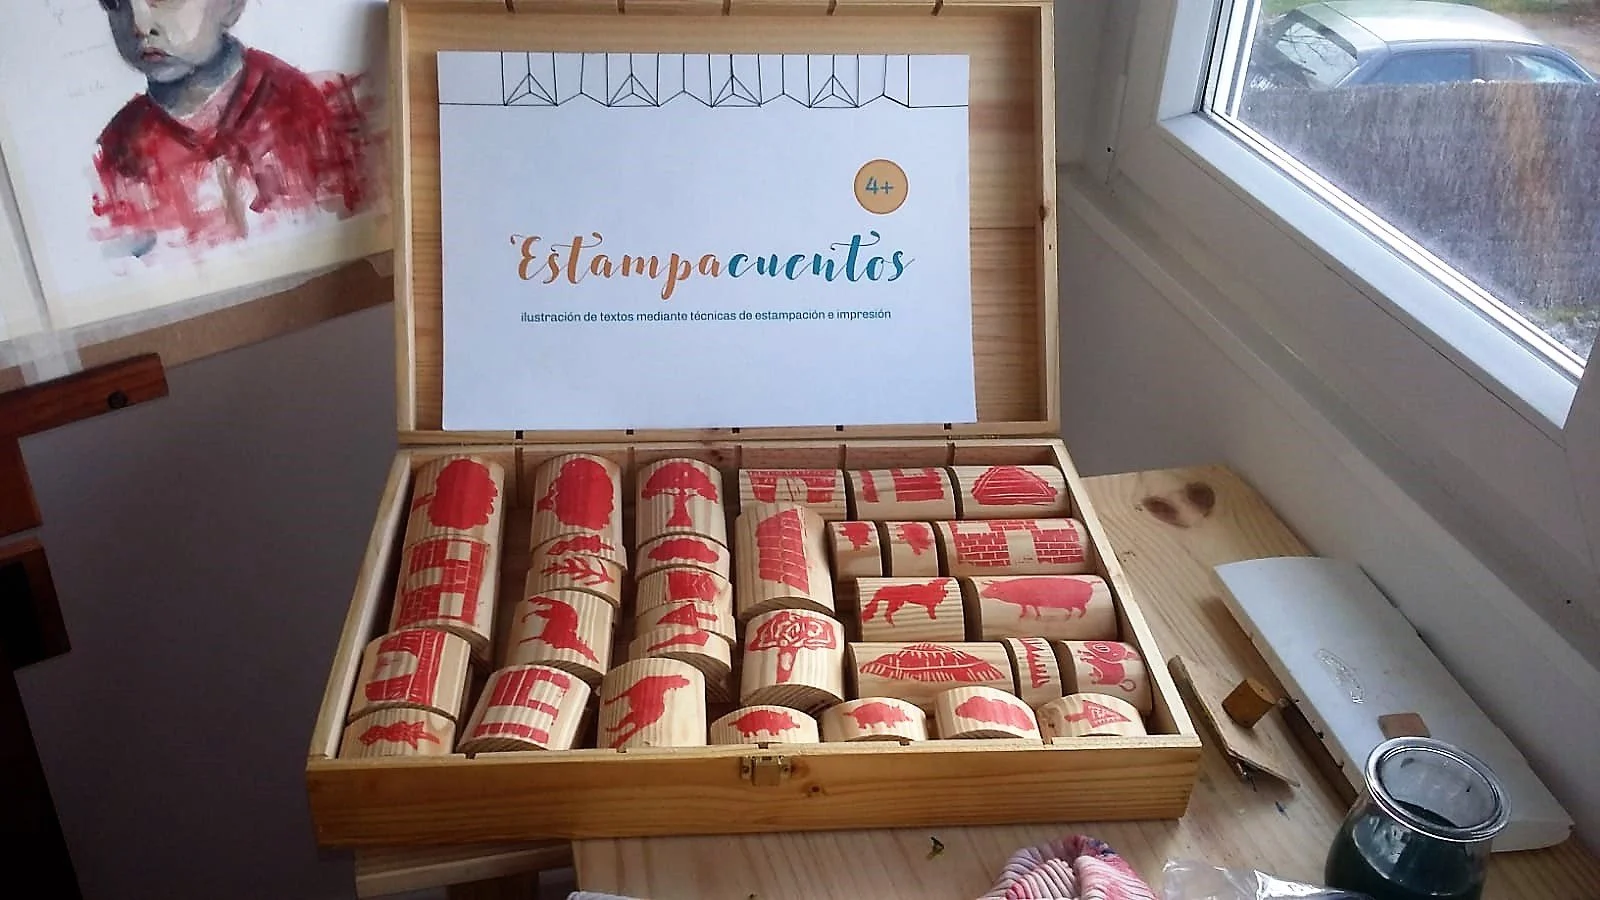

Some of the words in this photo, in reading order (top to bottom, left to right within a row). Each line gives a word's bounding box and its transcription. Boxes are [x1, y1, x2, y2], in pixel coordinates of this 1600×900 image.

[865, 176, 893, 195] 4+
[510, 231, 914, 300] Estampacuentos
[521, 311, 581, 323] ilustración
[583, 311, 598, 322] de
[599, 312, 635, 322] textos
[637, 311, 688, 322] mediante
[690, 310, 737, 321] técnicas
[738, 310, 753, 321] de
[754, 309, 826, 323] estampación
[827, 311, 836, 320] e
[836, 309, 892, 322] impresión
